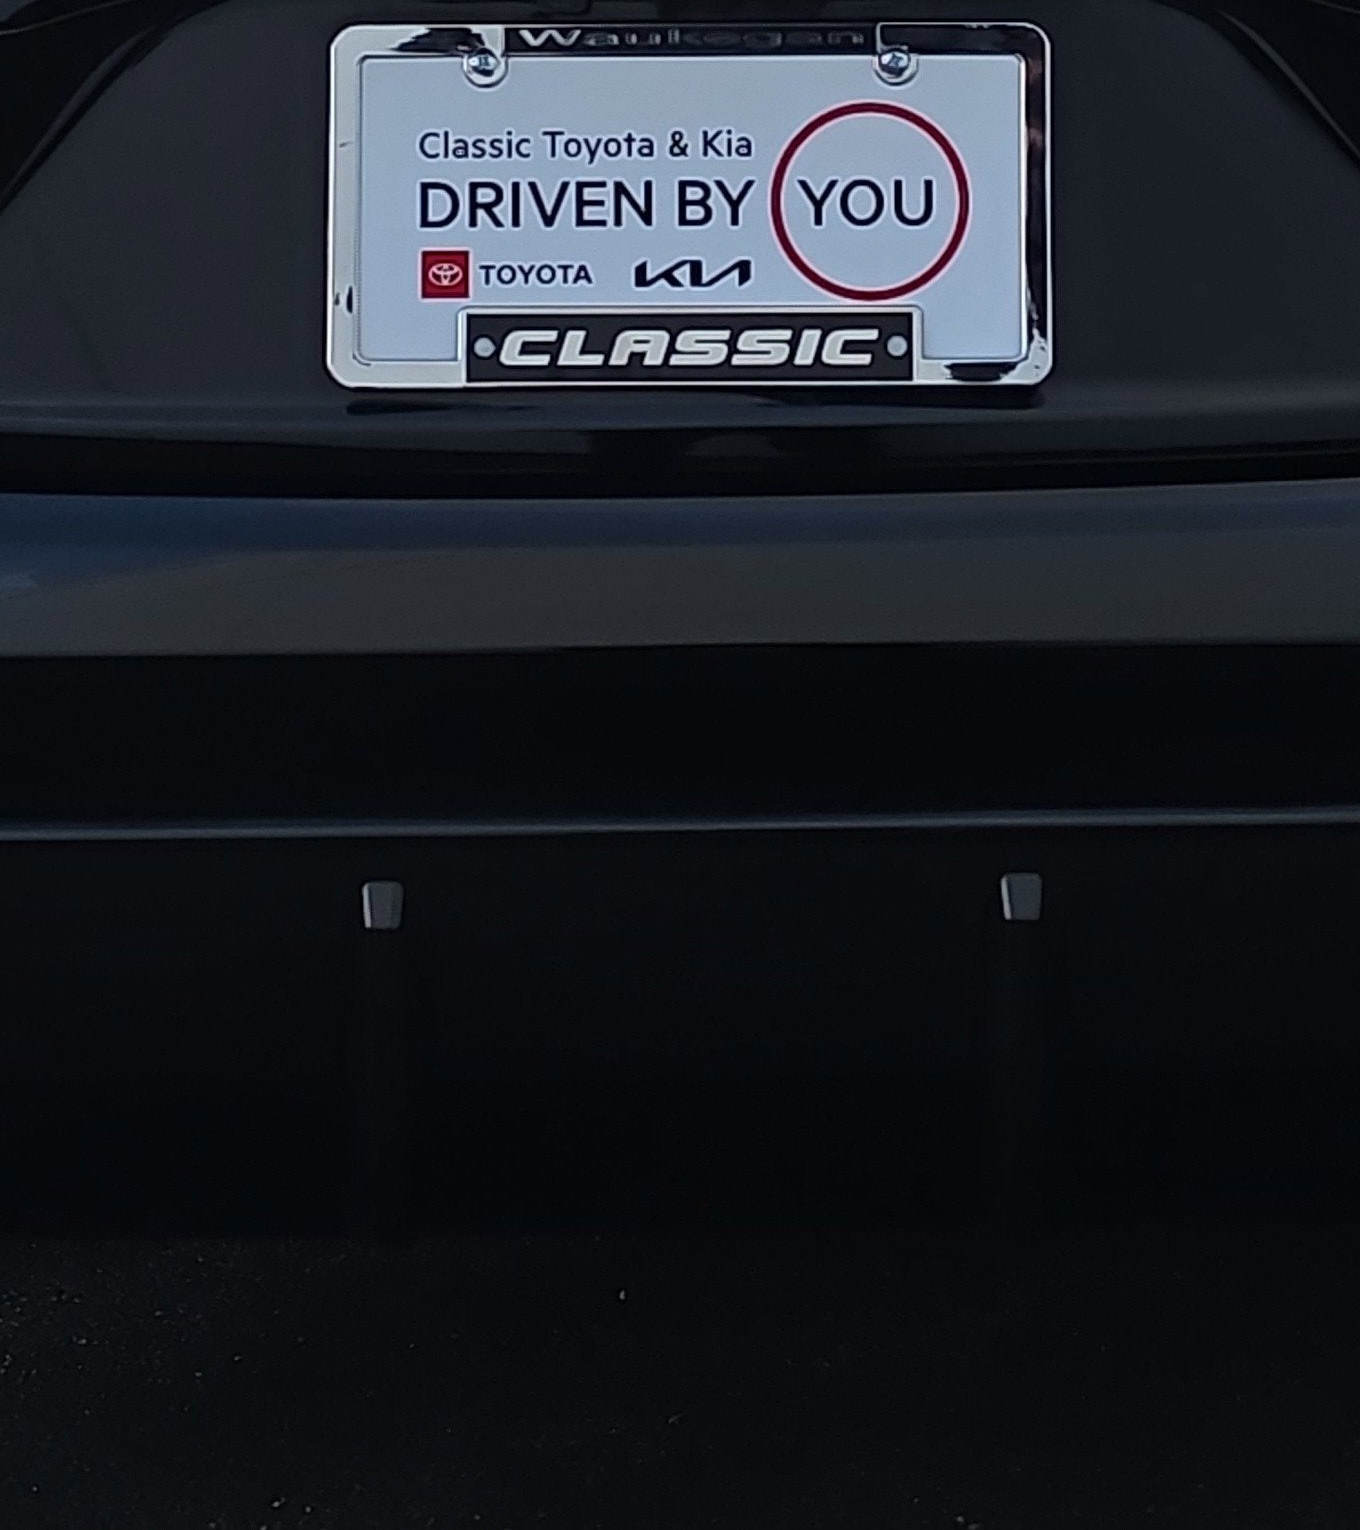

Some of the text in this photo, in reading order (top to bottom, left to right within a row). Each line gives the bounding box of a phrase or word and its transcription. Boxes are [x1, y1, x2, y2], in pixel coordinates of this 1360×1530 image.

[419, 129, 753, 165] Classic Toyota & Kia
[418, 177, 935, 229] DRIVEN BY YOU
[479, 263, 594, 286] TOYOTA
[497, 328, 881, 367] CLASSIC
